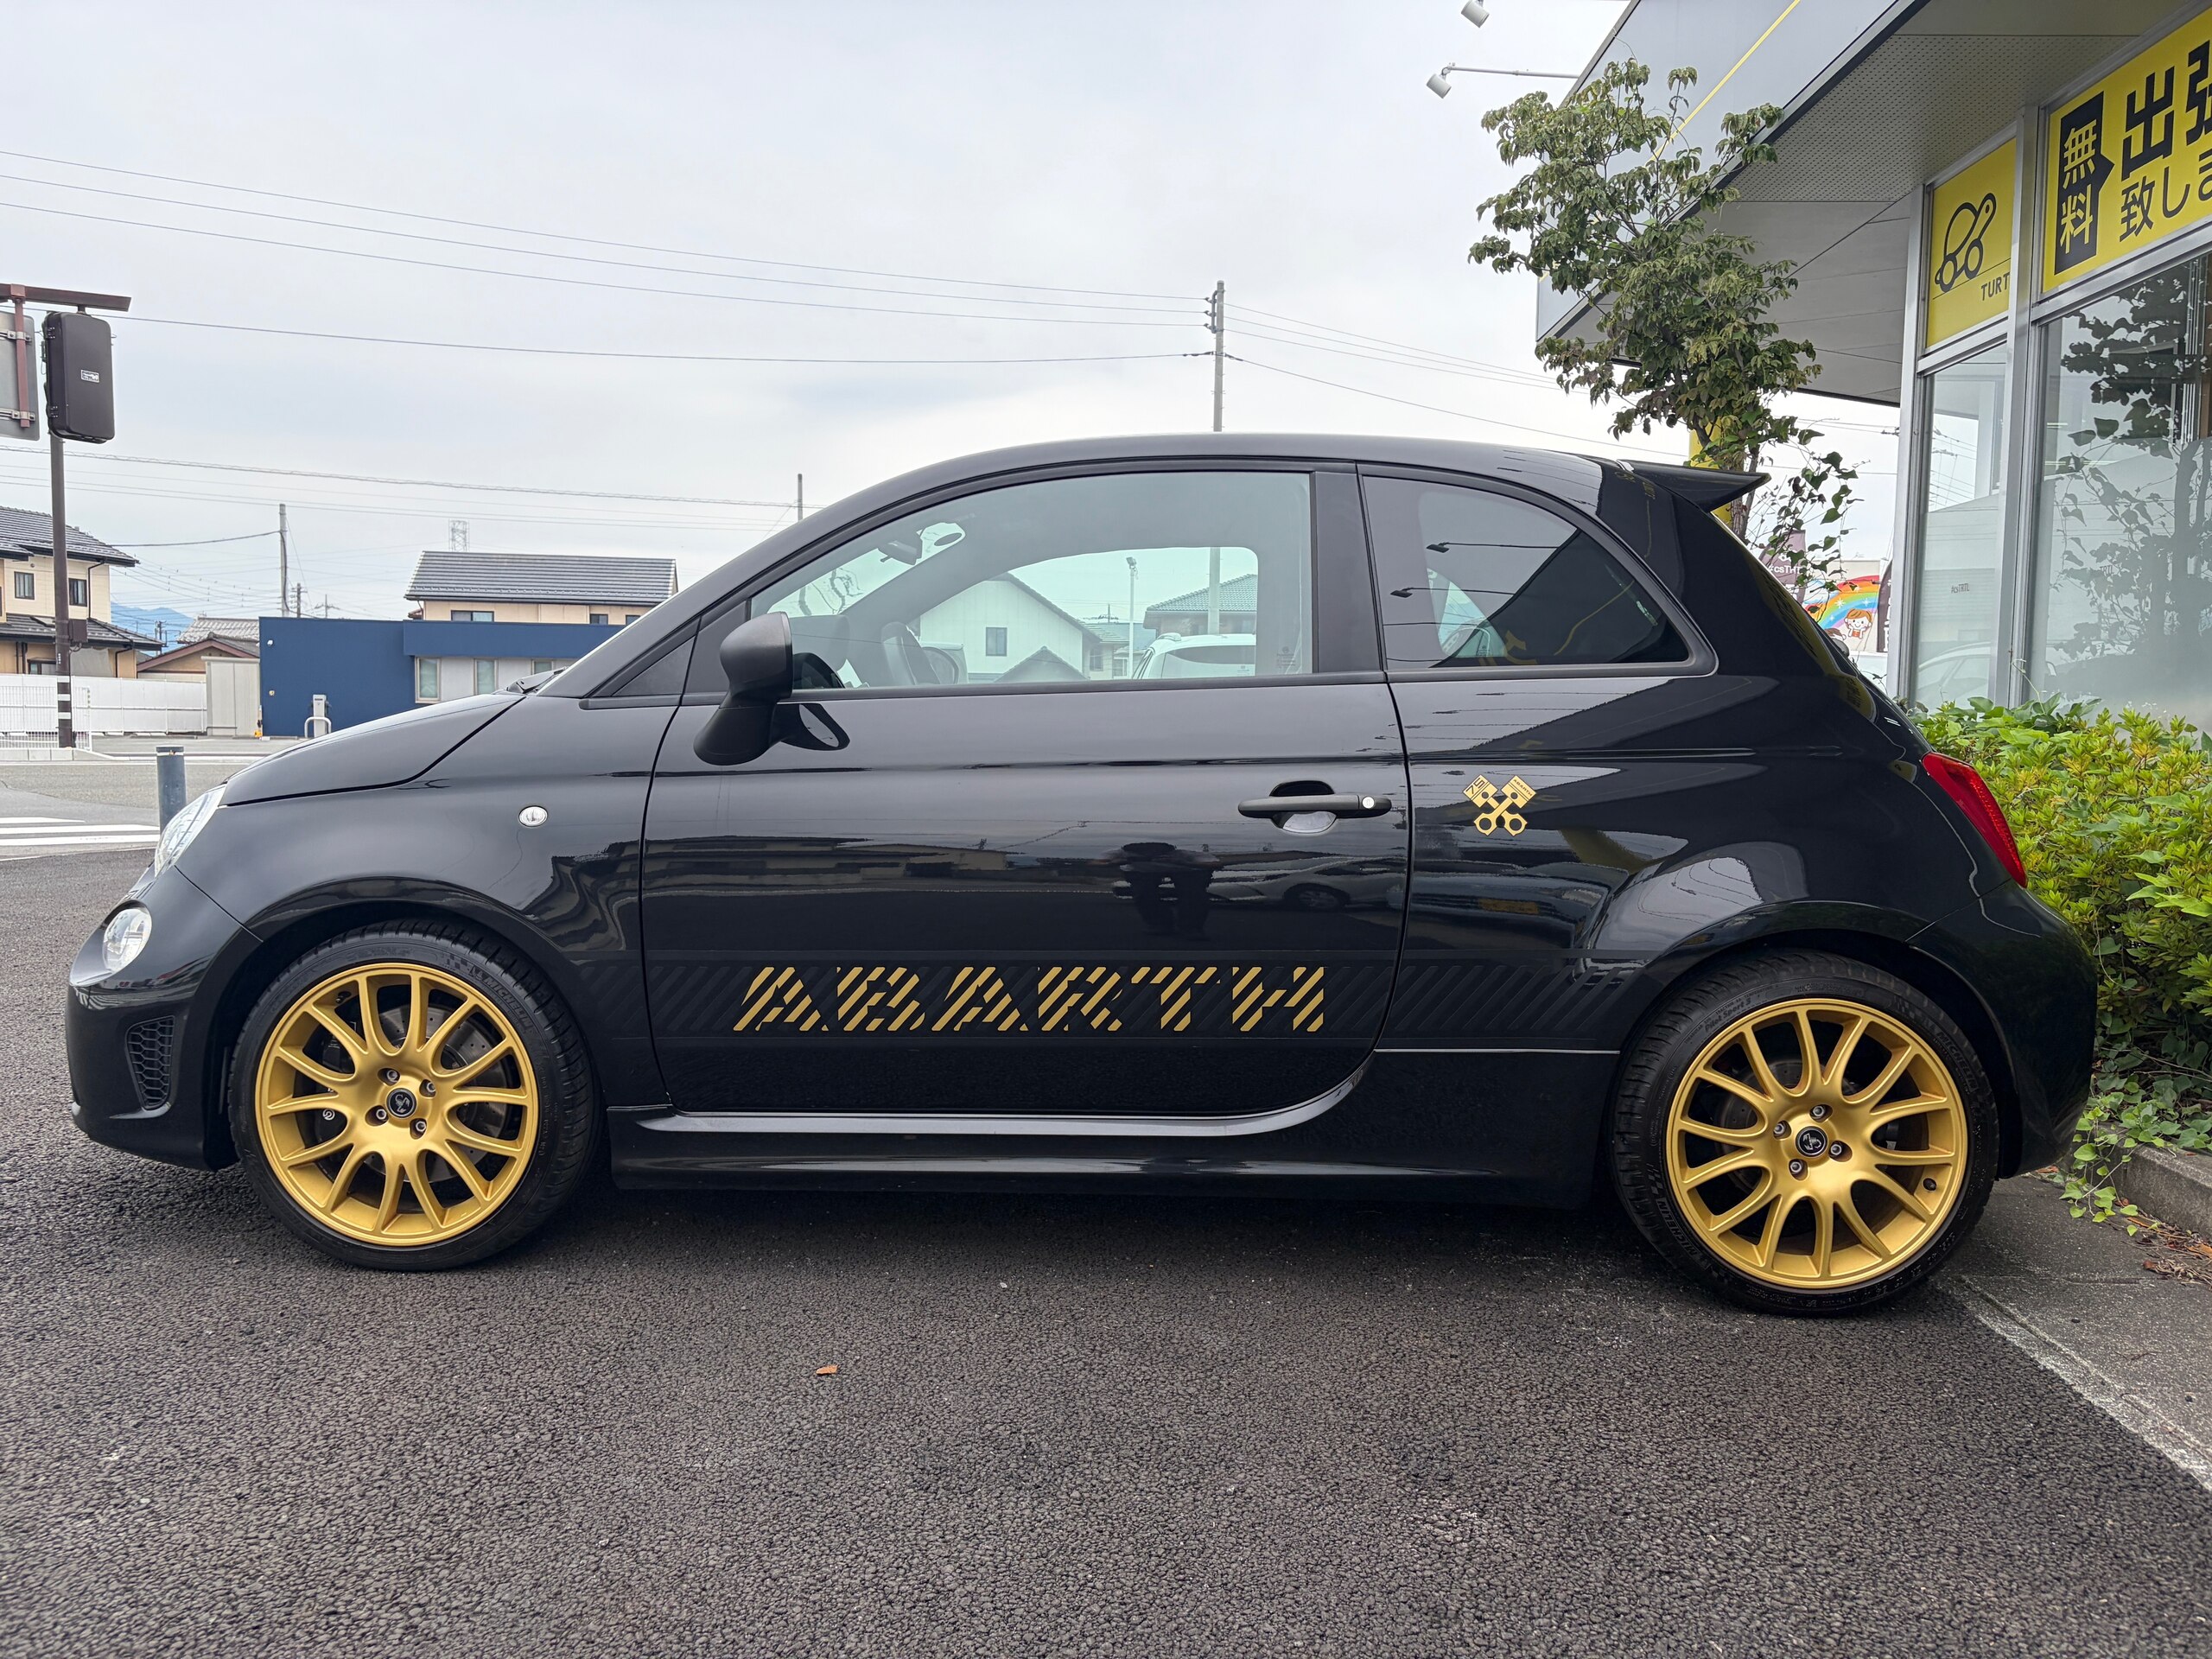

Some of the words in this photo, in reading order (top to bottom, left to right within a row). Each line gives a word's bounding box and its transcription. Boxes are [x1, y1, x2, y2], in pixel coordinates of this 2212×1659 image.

[2060, 119, 2097, 254] 無料
[1981, 271, 2010, 301] TURT
[1465, 778, 1485, 795] 75
[1513, 779, 1533, 797] ABARTH
[483, 976, 534, 1029] MICHELIN
[733, 967, 1325, 1032] ABARTH
[1705, 1015, 1722, 1033] Pilot
[1723, 1001, 1745, 1019] Sport
[1656, 1198, 1700, 1257] MICHELIN
